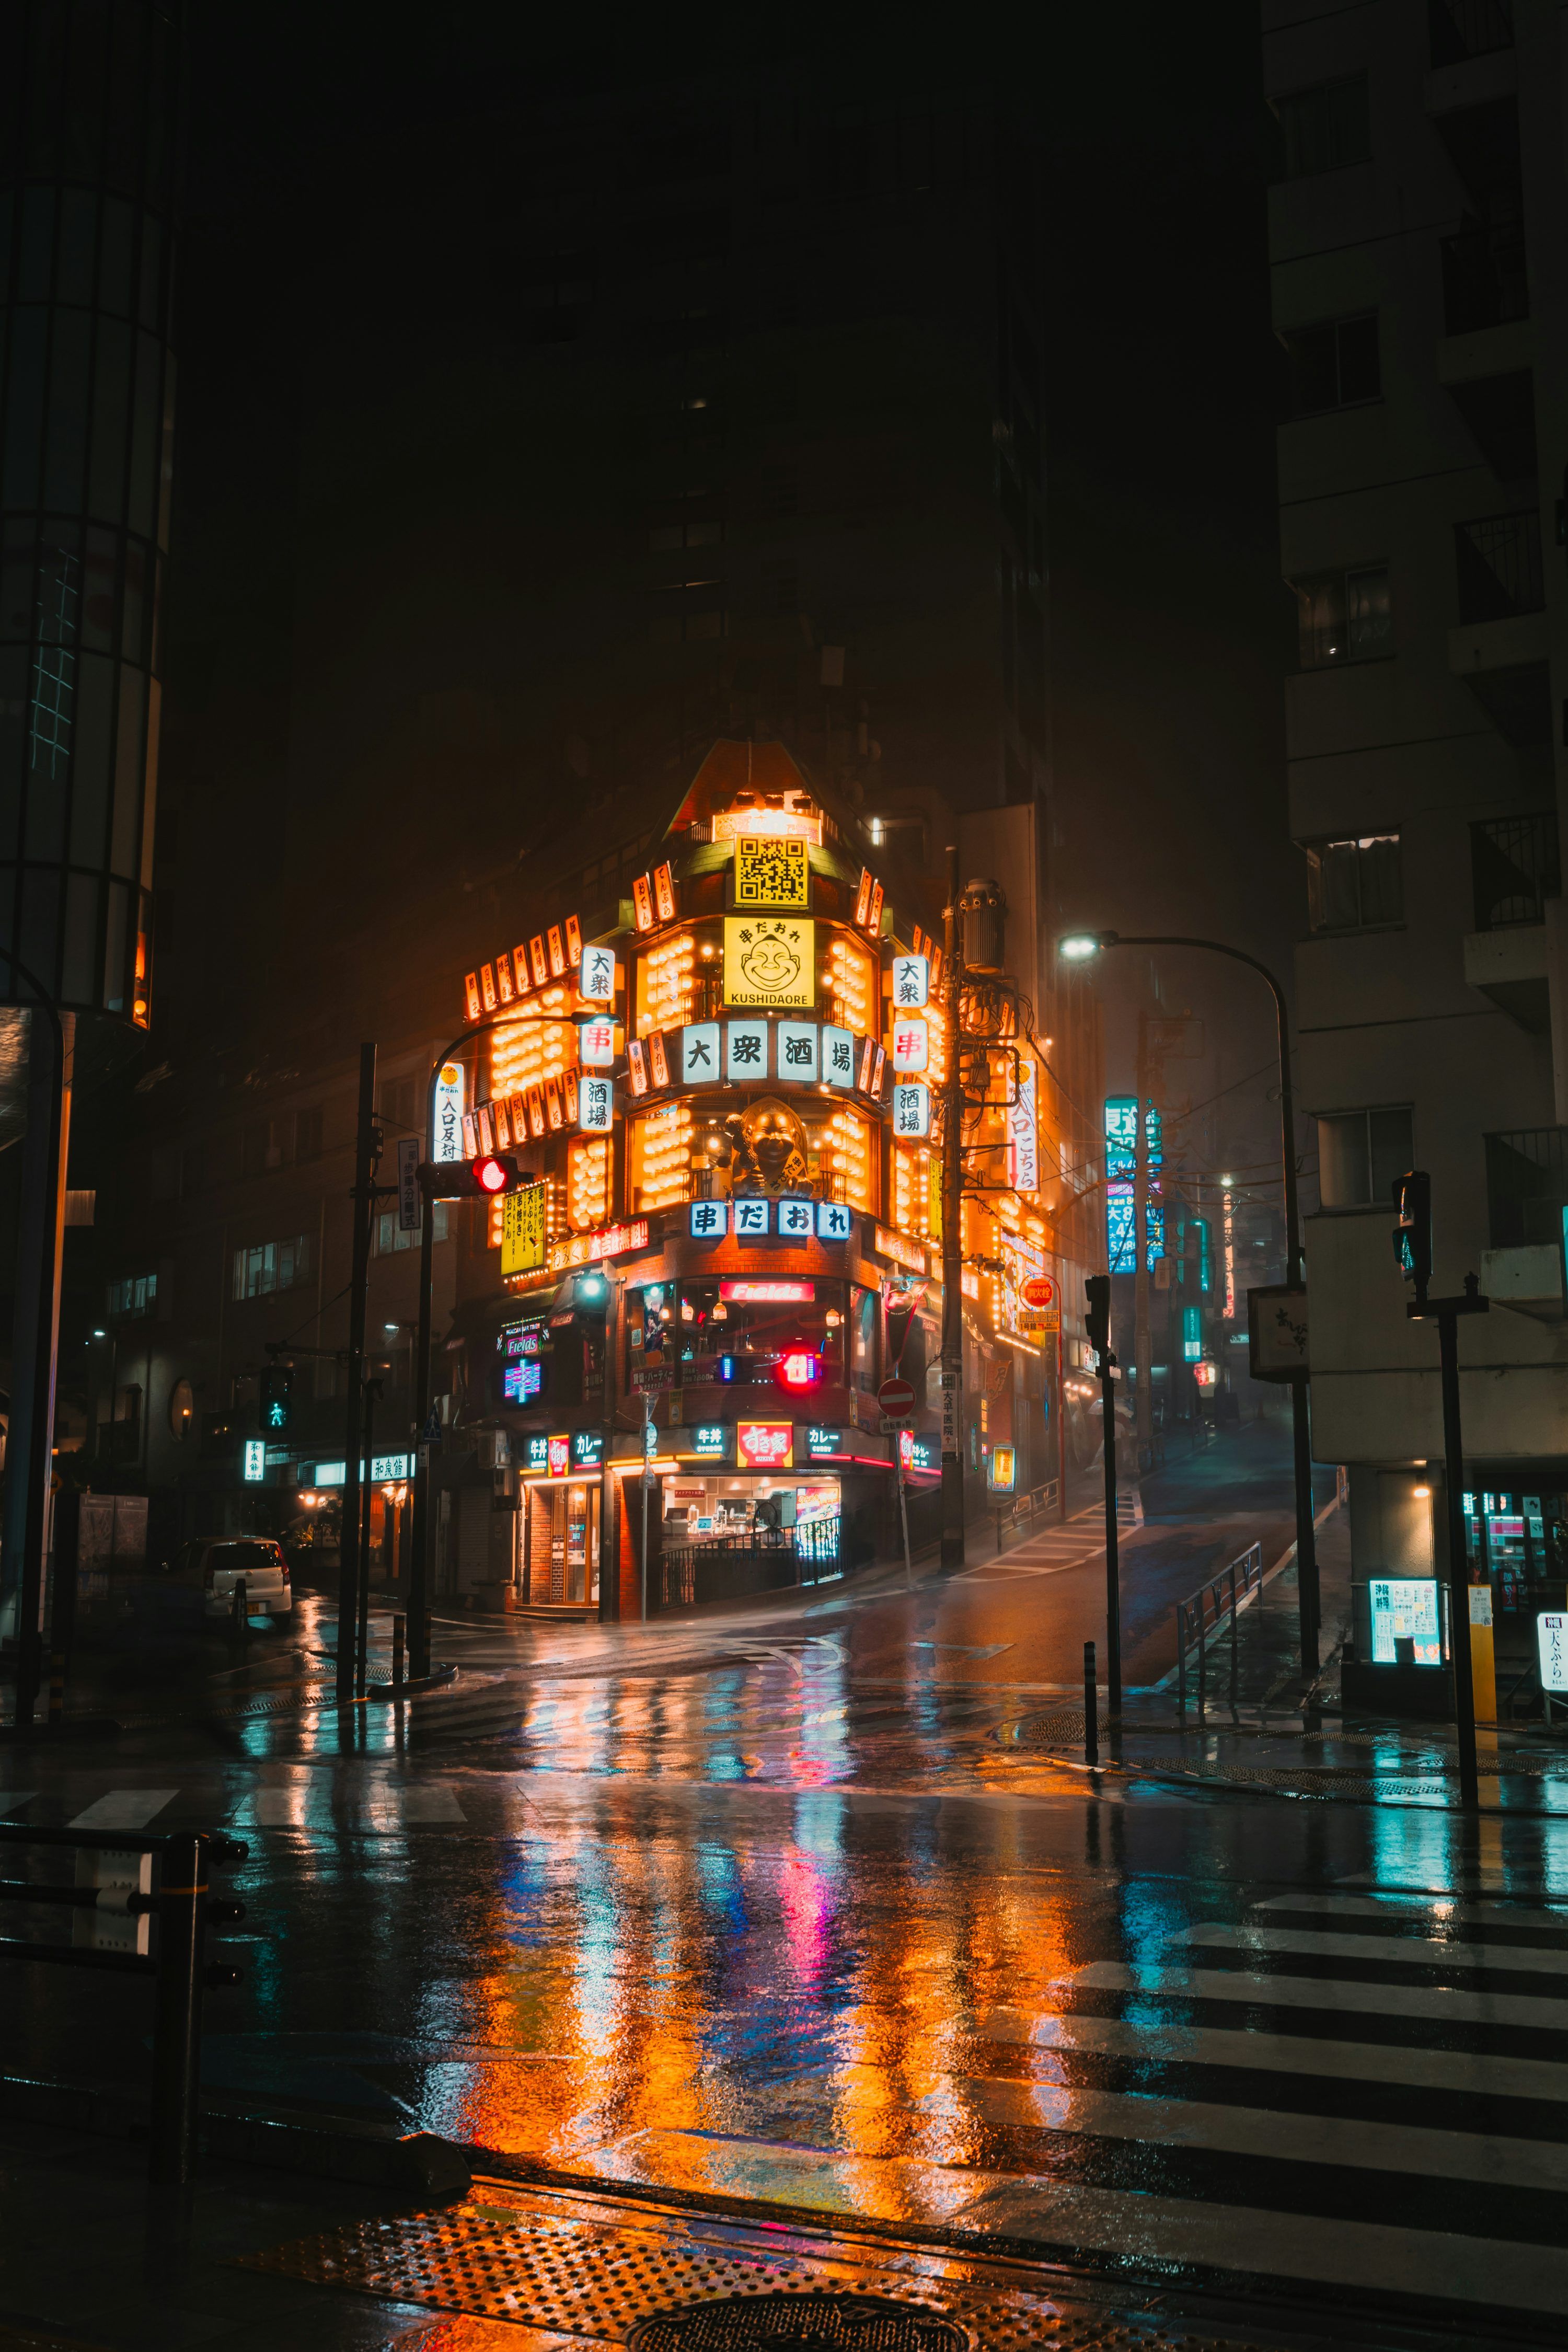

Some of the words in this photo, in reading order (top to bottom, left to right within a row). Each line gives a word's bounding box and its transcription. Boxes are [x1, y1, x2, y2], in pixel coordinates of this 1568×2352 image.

[739, 921, 801, 944] 串だおれ
[590, 952, 610, 995] 大衆
[732, 994, 808, 1005] KUSHIDAORE
[586, 1024, 610, 1055] 串
[688, 1035, 850, 1072] 大衆酒場
[896, 1028, 923, 1062] 串
[653, 1036, 663, 1081] 串カツ
[567, 1074, 578, 1120] 生ビール
[587, 1082, 607, 1126] 酒場
[900, 1089, 920, 1131] 酒場
[441, 1097, 457, 1162] 入口反対
[769, 1156, 802, 1191] 串だおれ
[695, 1204, 846, 1233] 串だおれ
[732, 1285, 802, 1299] Fields
[1027, 1287, 1051, 1299] 消火栓
[508, 1338, 536, 1355] Fields
[883, 1419, 915, 1431] 自転車を除く
[943, 1391, 954, 1436] 大平医院
[531, 1439, 547, 1459] 牛丼
[577, 1435, 602, 1454] カレー
[698, 1428, 721, 1444] 牛丼
[742, 1426, 787, 1455] すき家
[810, 1429, 839, 1443] カレー
